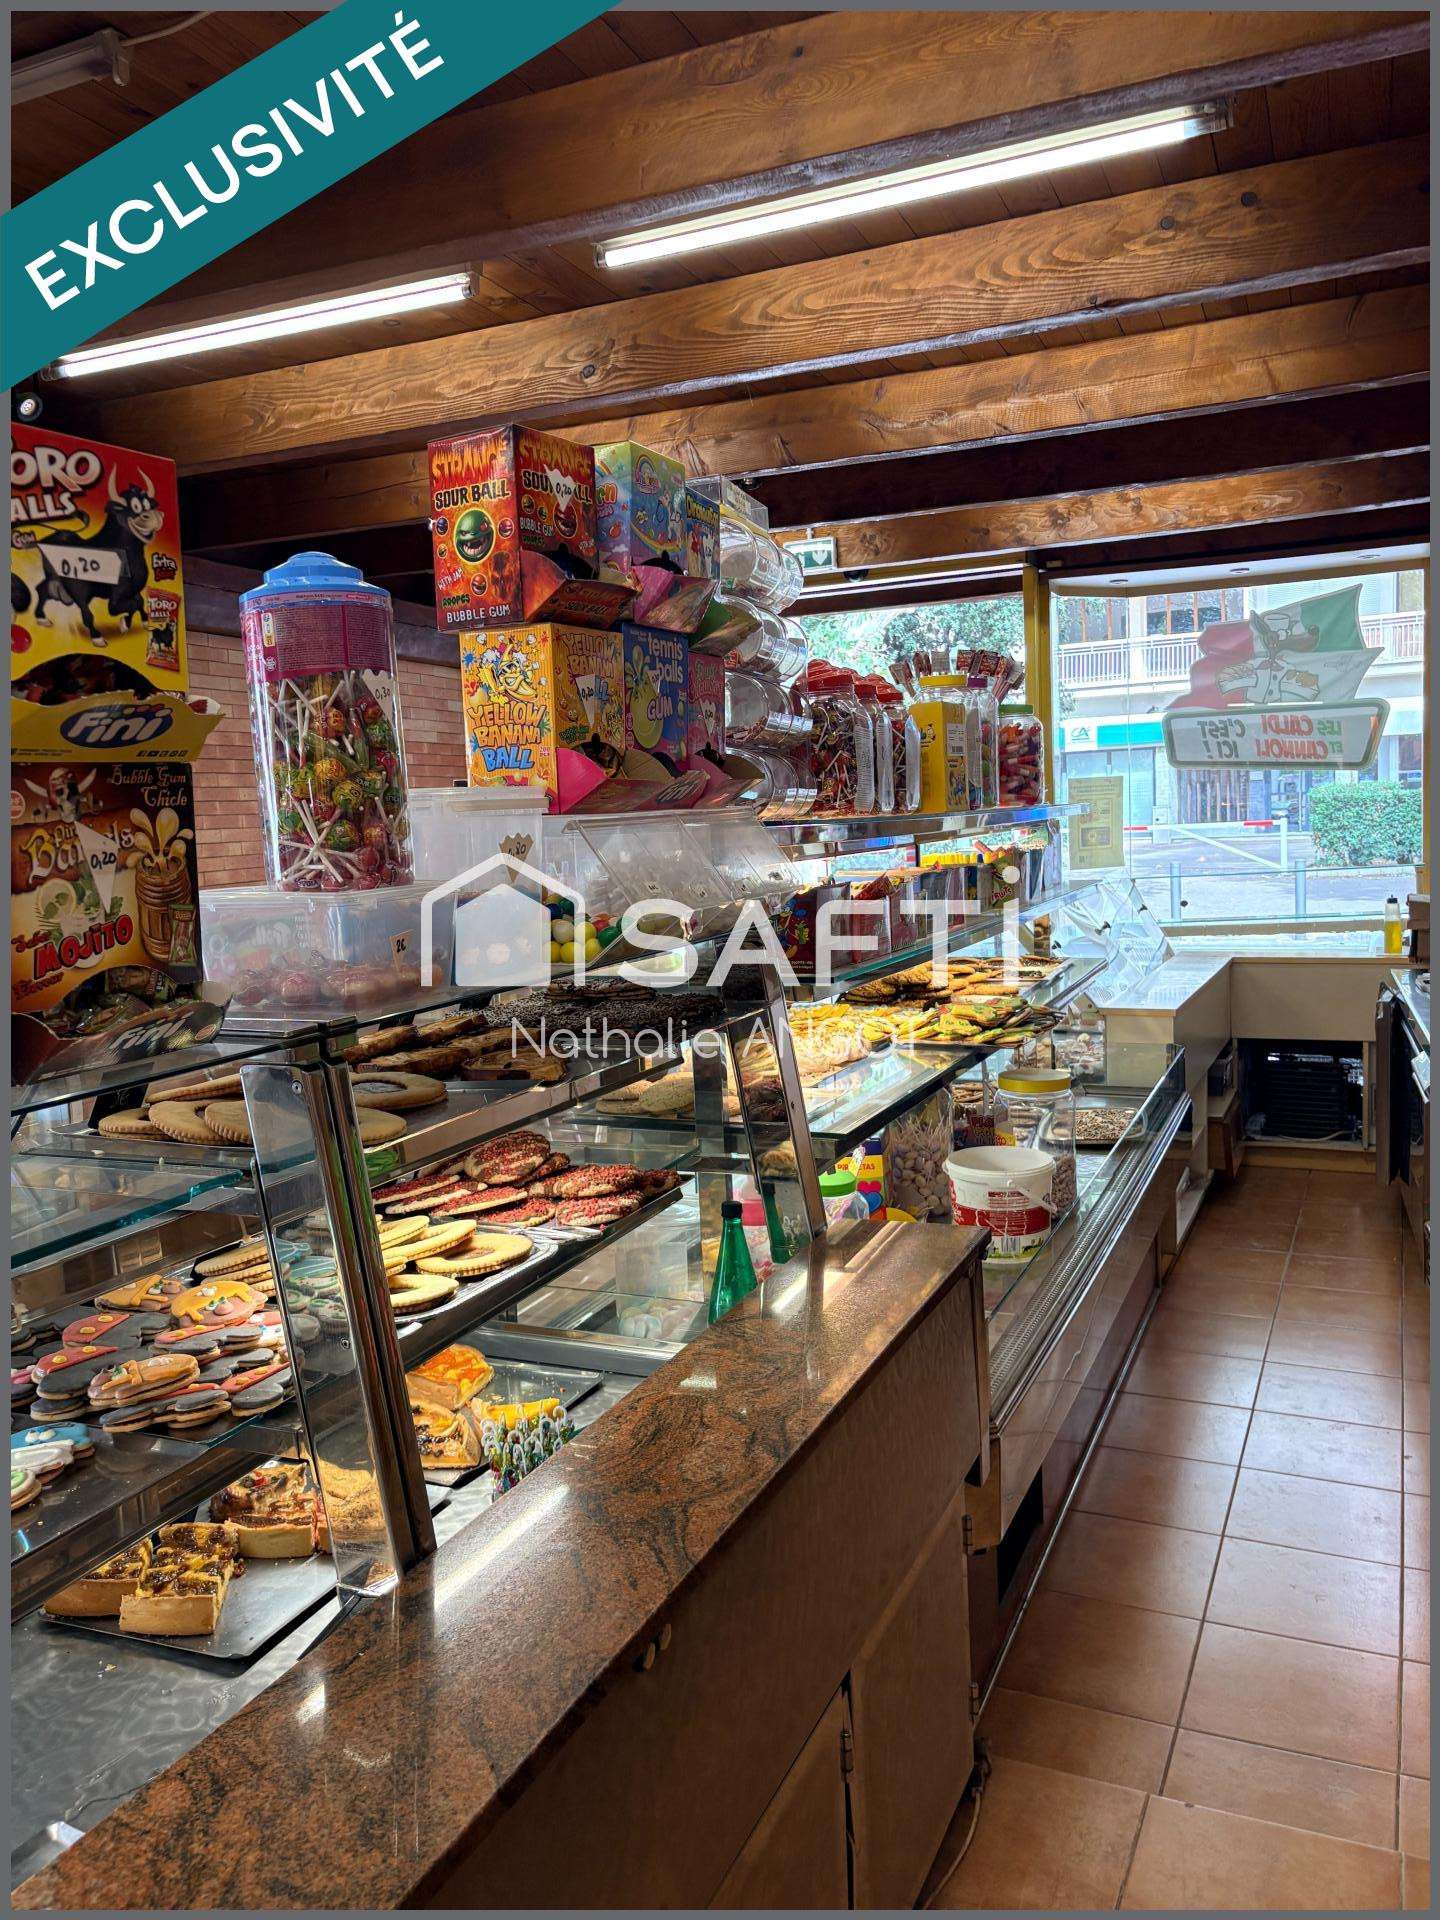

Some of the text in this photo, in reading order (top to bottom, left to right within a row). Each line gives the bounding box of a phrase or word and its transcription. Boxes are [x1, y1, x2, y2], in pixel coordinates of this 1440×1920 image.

[434, 478, 511, 511] SOUR BALL
[555, 481, 573, 498] 0,20
[60, 556, 101, 578] 0,20
[149, 598, 178, 612] TORO
[446, 604, 511, 624] BUBBLE GUM
[561, 632, 615, 656] YELLOW
[467, 701, 548, 728] YELLOW
[646, 695, 673, 721] GUM
[67, 705, 172, 744] Fini
[473, 725, 542, 748] BANANA
[481, 744, 536, 772] BALL
[111, 764, 187, 787] Bubble Gum
[141, 785, 188, 807] Chicle
[90, 851, 117, 870] 0,20
[33, 914, 134, 979] MOJITO
[108, 1010, 195, 1050] Fini
